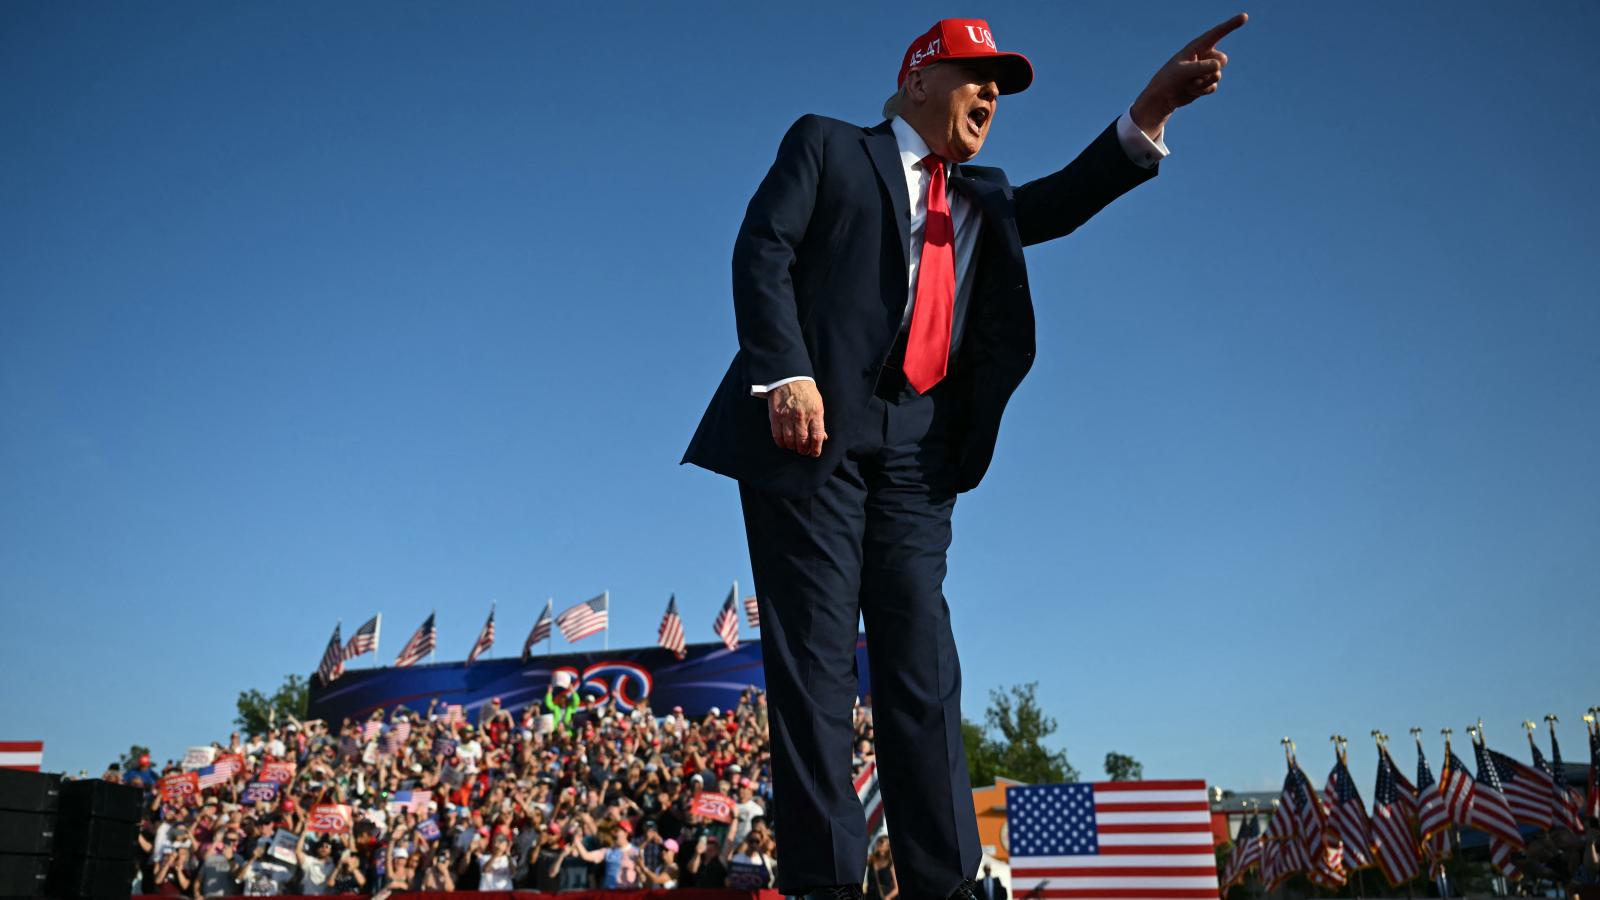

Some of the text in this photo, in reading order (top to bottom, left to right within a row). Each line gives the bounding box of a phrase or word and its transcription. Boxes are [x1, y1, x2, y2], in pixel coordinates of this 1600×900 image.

[964, 25, 997, 53] US
[909, 38, 941, 68] 45-47
[247, 788, 274, 800] 250
[697, 799, 730, 817] 250
[314, 814, 345, 831] 250
